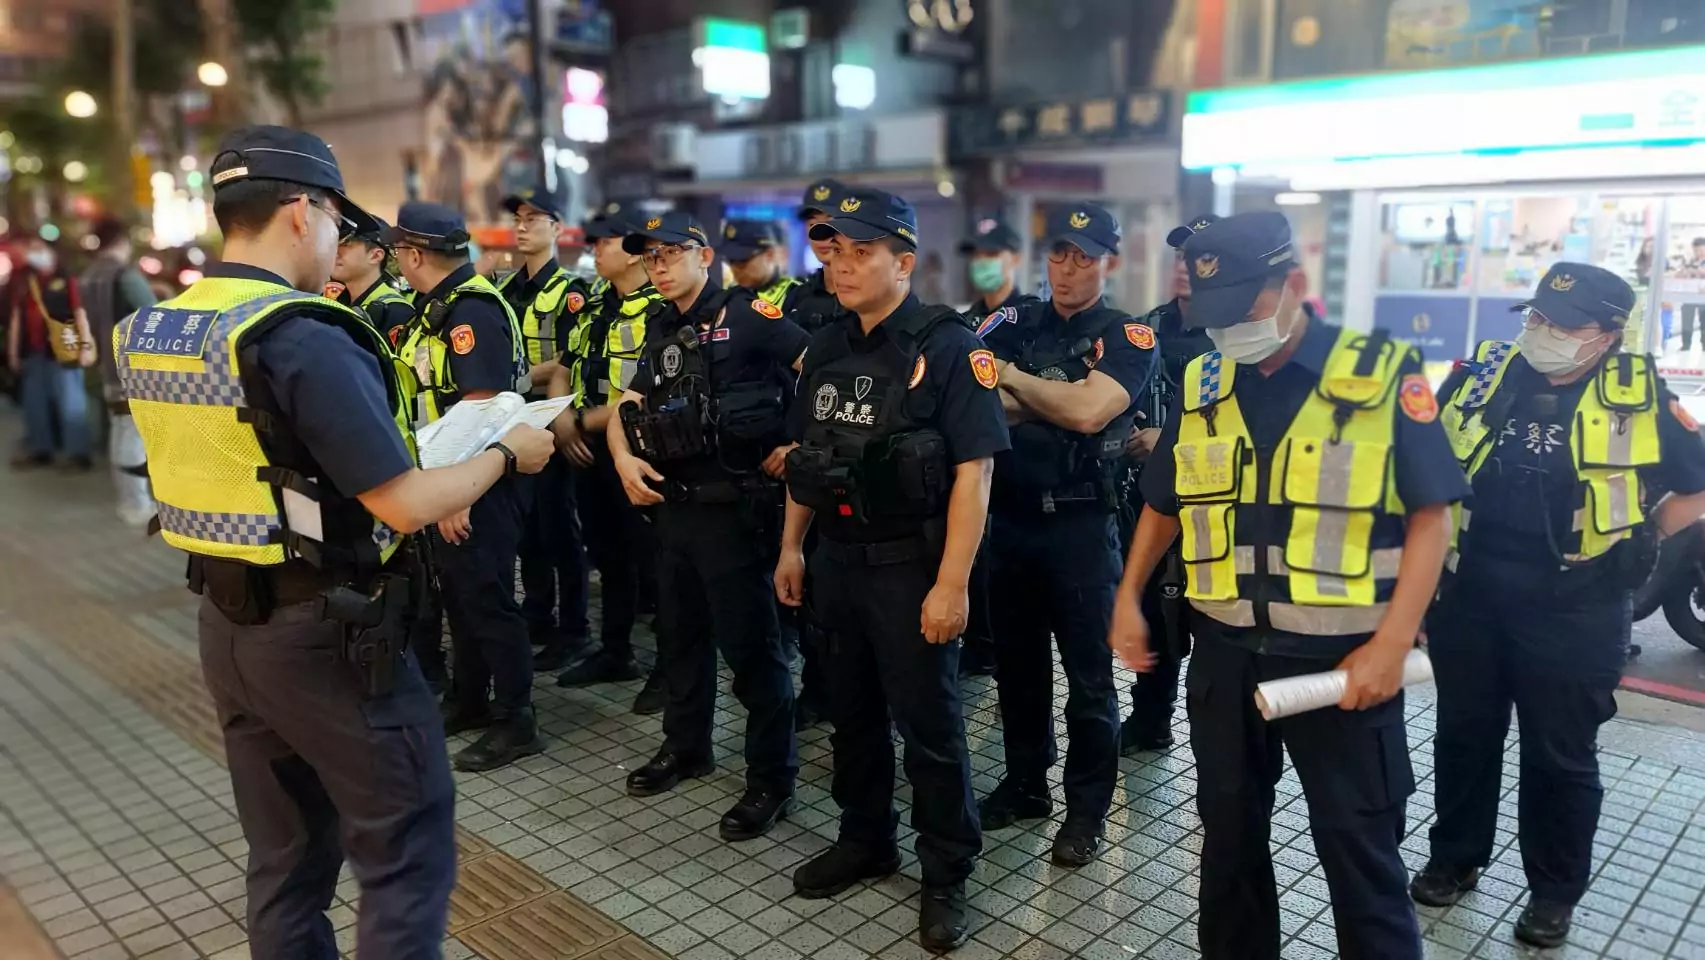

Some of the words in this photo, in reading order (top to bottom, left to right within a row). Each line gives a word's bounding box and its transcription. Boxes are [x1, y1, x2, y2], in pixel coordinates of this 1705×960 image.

[143, 311, 209, 336] 警察
[136, 337, 194, 352] POLICE
[834, 411, 875, 425] POLICE
[1180, 472, 1228, 486] POLICE
